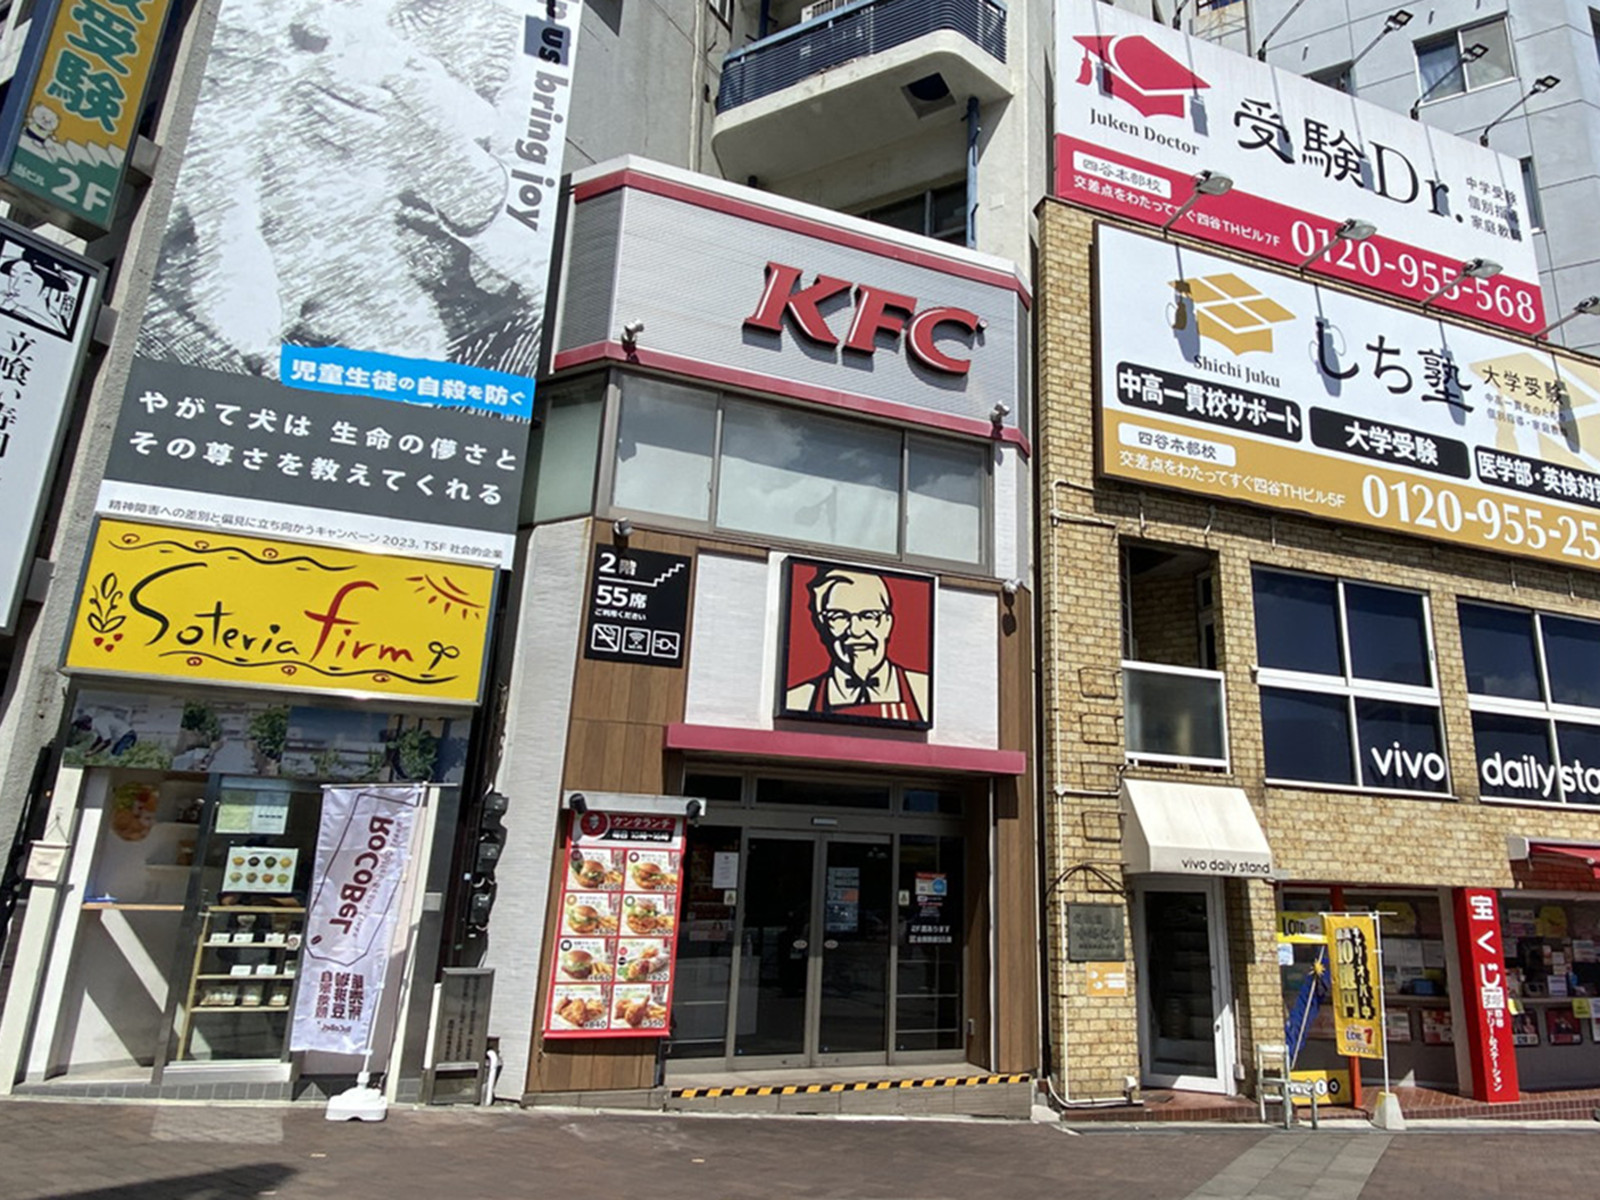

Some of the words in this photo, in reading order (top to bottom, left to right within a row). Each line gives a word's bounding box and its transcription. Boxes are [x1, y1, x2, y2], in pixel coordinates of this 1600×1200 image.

[46, 0, 146, 133] 受験
[538, 27, 564, 65] us
[515, 71, 569, 165] bring
[1090, 107, 1139, 136] Juken
[1144, 126, 1200, 156] Doctor
[51, 166, 112, 211] 2F
[1082, 158, 1162, 194] 四谷本部校
[1233, 98, 1463, 224] 受験Dr.
[506, 169, 555, 231] joy
[1291, 220, 1536, 324] 0120-955-568
[742, 261, 980, 374] KFC
[290, 358, 526, 407] 児童生徒の自殺を防ぐ
[1194, 355, 1242, 378] Shichi
[1246, 367, 1281, 387] Juku
[1316, 320, 1475, 413] しち塾
[1482, 365, 1564, 406] 大学受験
[1119, 368, 1300, 434] 中高一貫校サポート
[139, 391, 311, 436] やがて犬は
[330, 420, 517, 471] 生命の儚さと
[1138, 431, 1217, 460] 四谷本部校
[1344, 421, 1439, 466] 大学受験
[129, 431, 502, 505] その尊さを教えてくれる
[1120, 450, 1346, 508] 交差点をわたってすぐ四谷THビル5F
[599, 552, 638, 576] 2階
[129, 562, 300, 655] Soteria
[303, 580, 414, 662] firm
[595, 584, 648, 609] 55席
[1371, 741, 1446, 782] vivo
[1481, 752, 1556, 798] daily
[1181, 859, 1207, 871] vivo
[1209, 859, 1237, 873] daily
[1239, 862, 1271, 874] stand
[1470, 895, 1502, 989] 宝くじ
